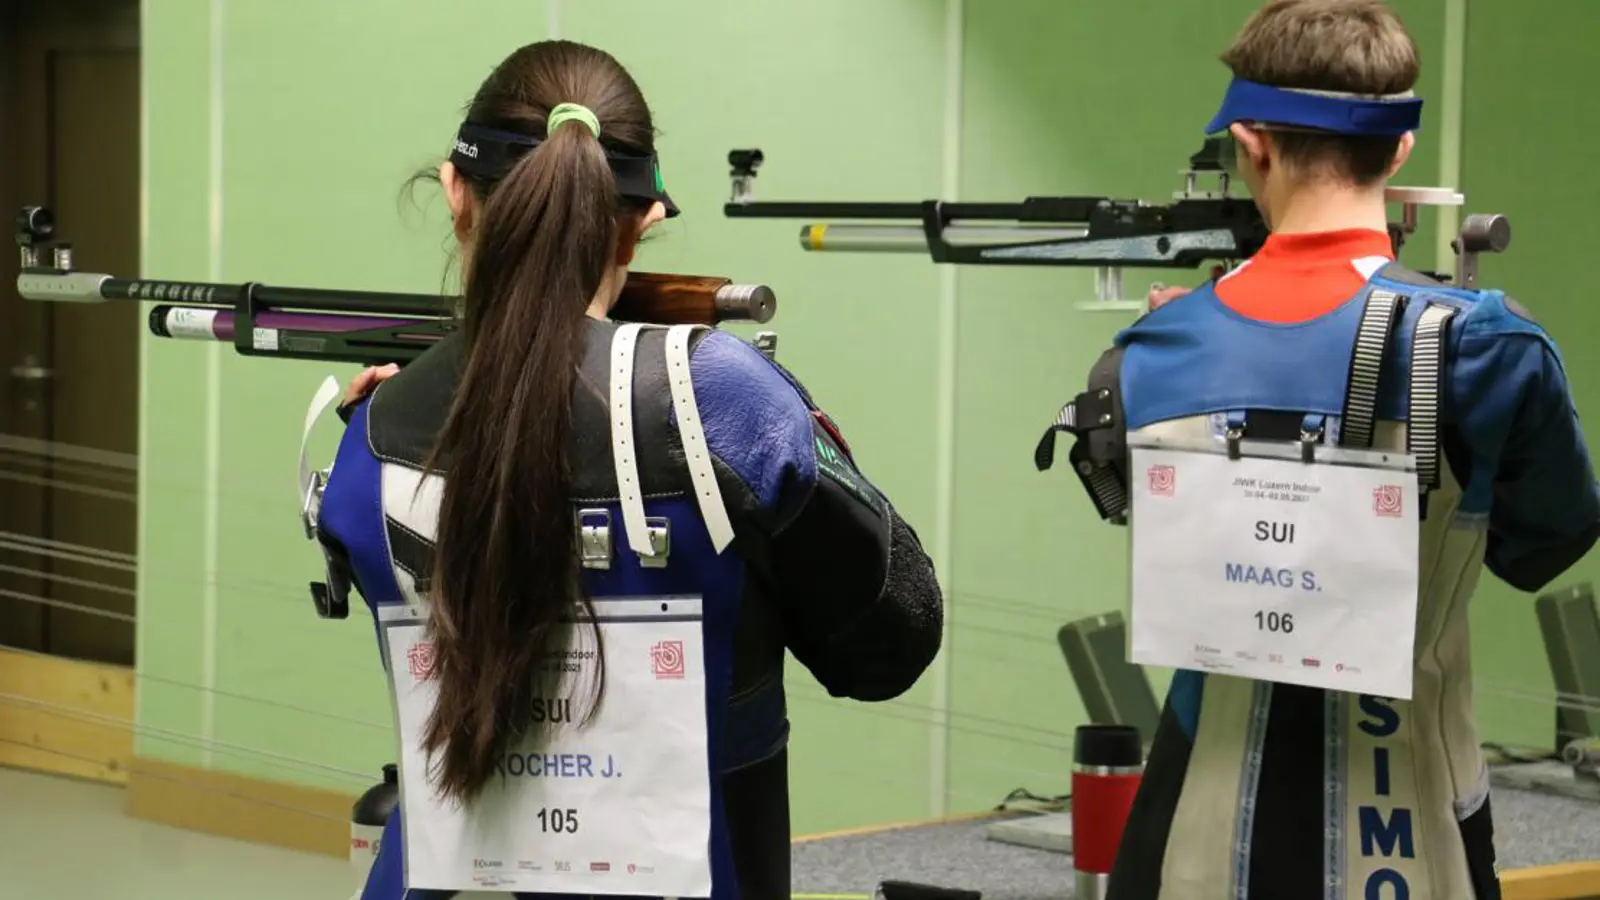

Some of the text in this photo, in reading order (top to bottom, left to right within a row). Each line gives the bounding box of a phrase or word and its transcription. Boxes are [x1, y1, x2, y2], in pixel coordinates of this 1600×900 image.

[1254, 520, 1295, 543] SUI
[1225, 563, 1323, 592] MAAG S.
[1254, 610, 1294, 634] 106
[532, 698, 571, 723] SUI
[601, 754, 622, 778] J.
[537, 807, 578, 833] 105
